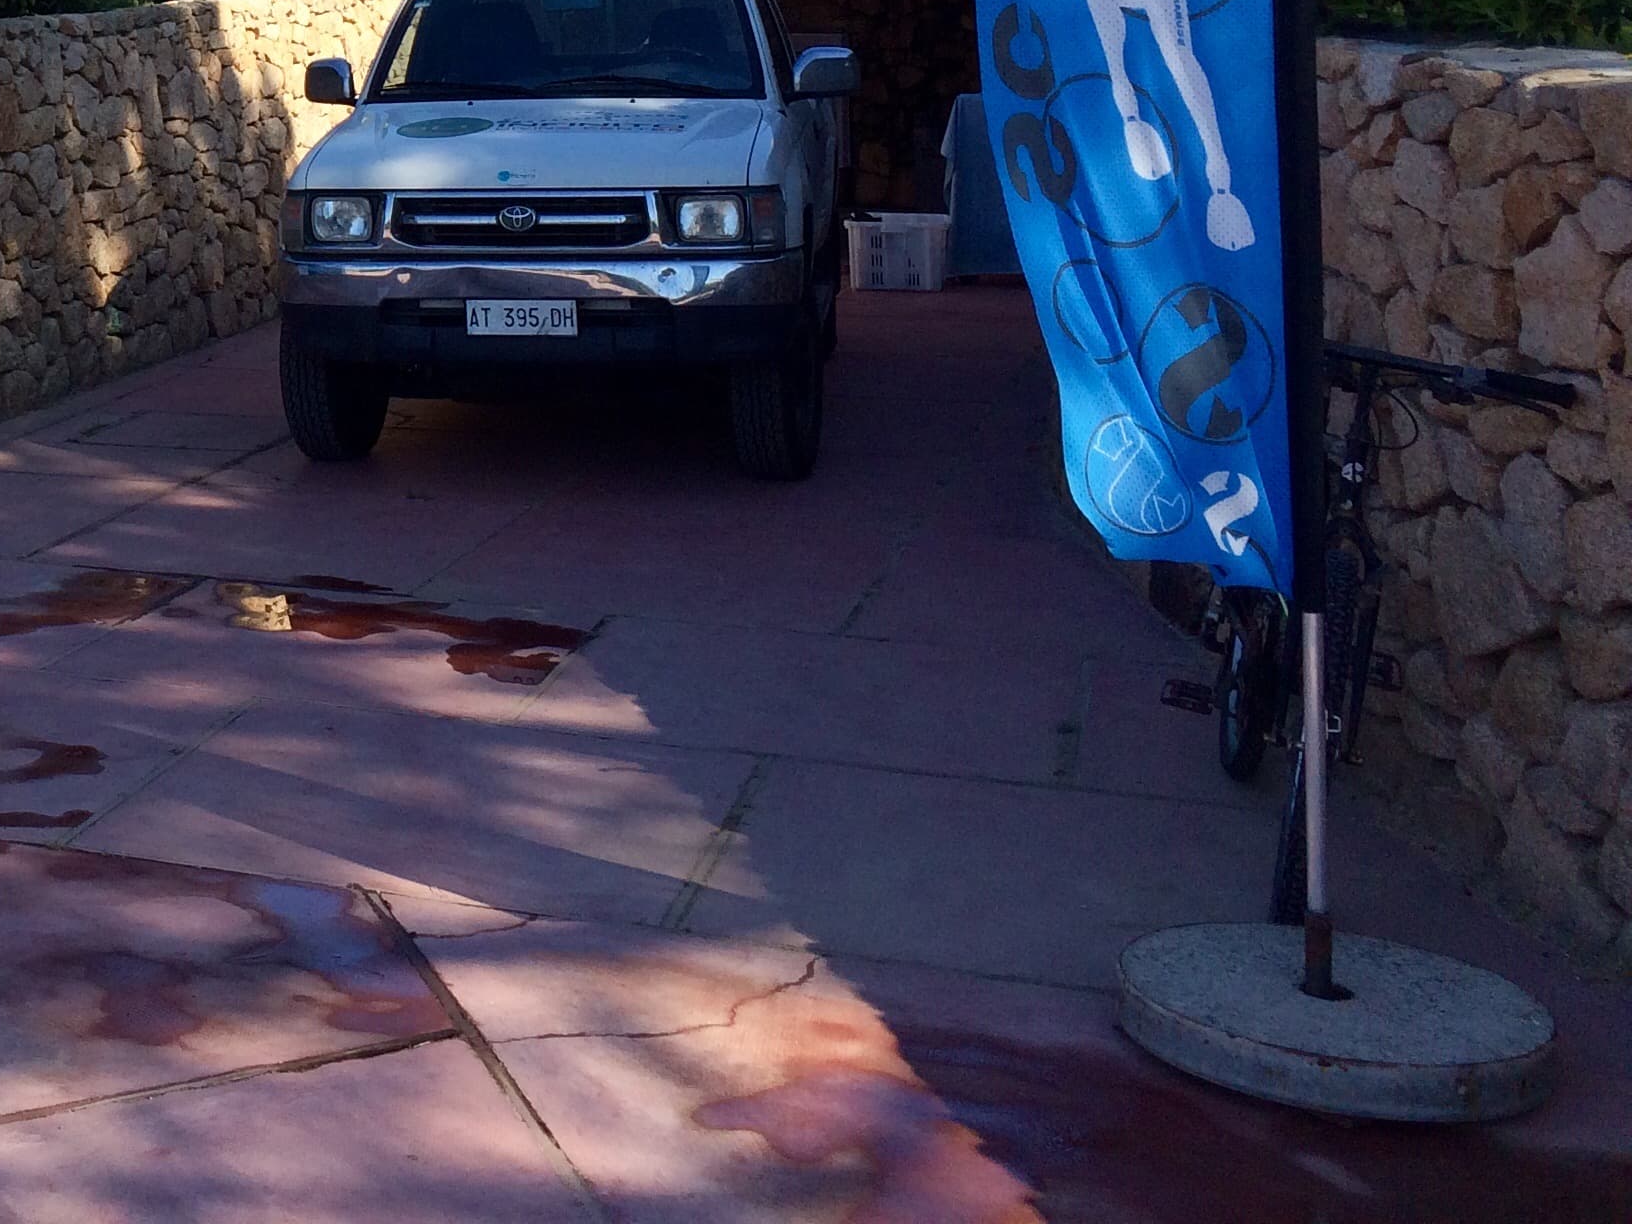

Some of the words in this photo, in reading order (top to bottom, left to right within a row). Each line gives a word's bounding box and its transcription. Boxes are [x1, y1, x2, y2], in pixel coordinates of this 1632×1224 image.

[469, 306, 491, 328] AT
[503, 306, 540, 328] 395
[550, 306, 575, 328] DH
